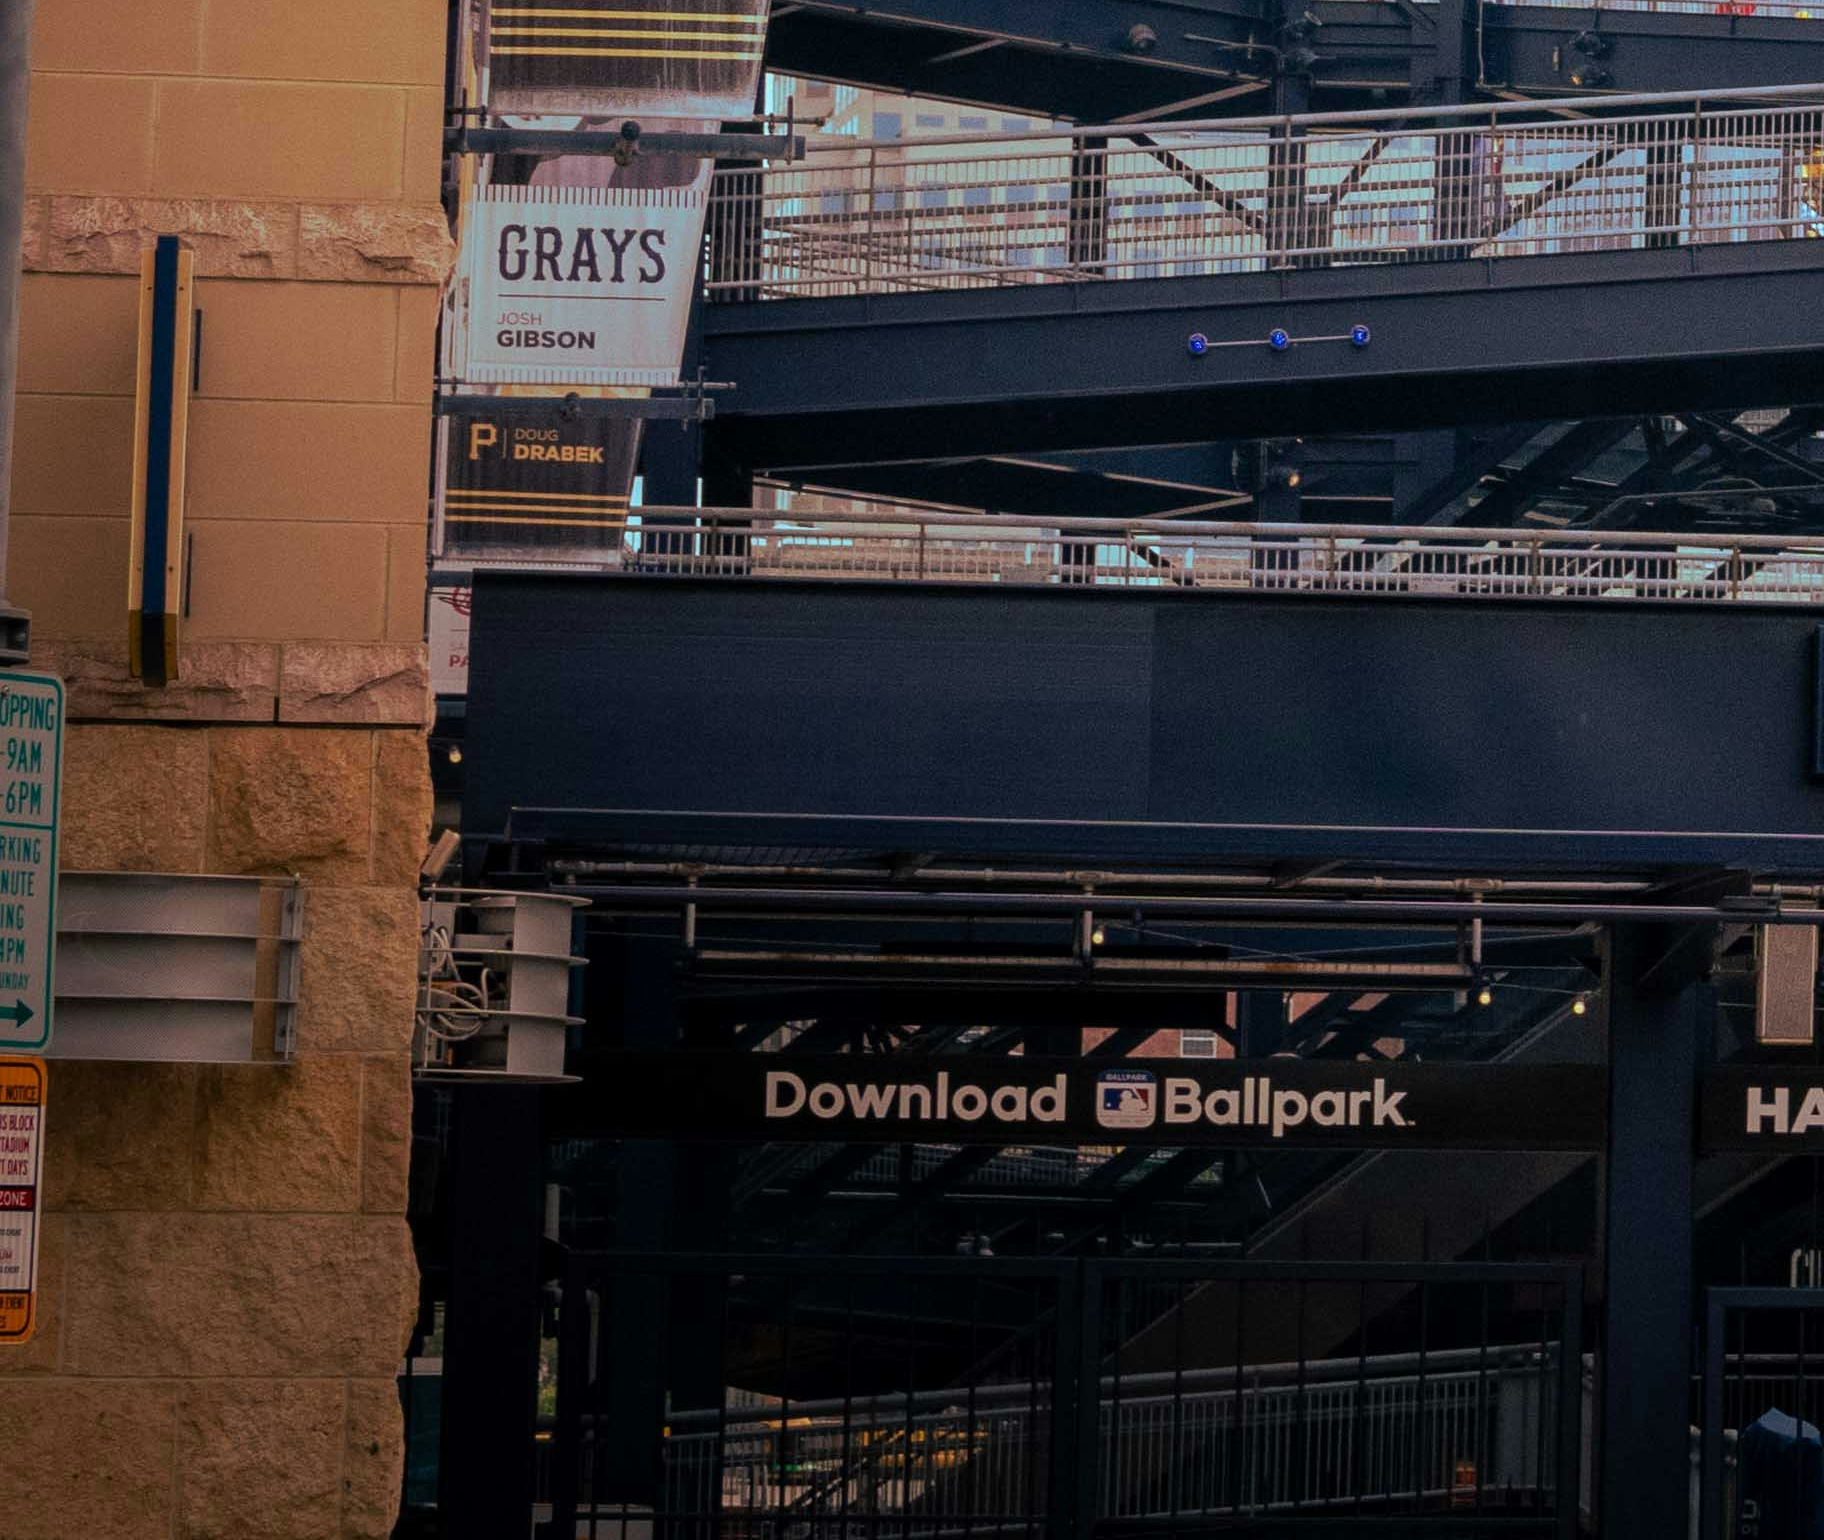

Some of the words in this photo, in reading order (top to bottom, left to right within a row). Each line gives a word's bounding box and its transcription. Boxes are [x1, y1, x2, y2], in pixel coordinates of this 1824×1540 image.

[498, 224, 666, 283] GRAYS
[497, 312, 542, 325] JOSH
[497, 330, 596, 349] GIBSON
[469, 423, 497, 460] P
[514, 428, 559, 441] DOUG
[514, 444, 604, 463] DRABEK
[6, 1085, 38, 1102] NOTICE
[766, 1071, 1066, 1121] Download
[10, 1115, 35, 1132] BLOCK
